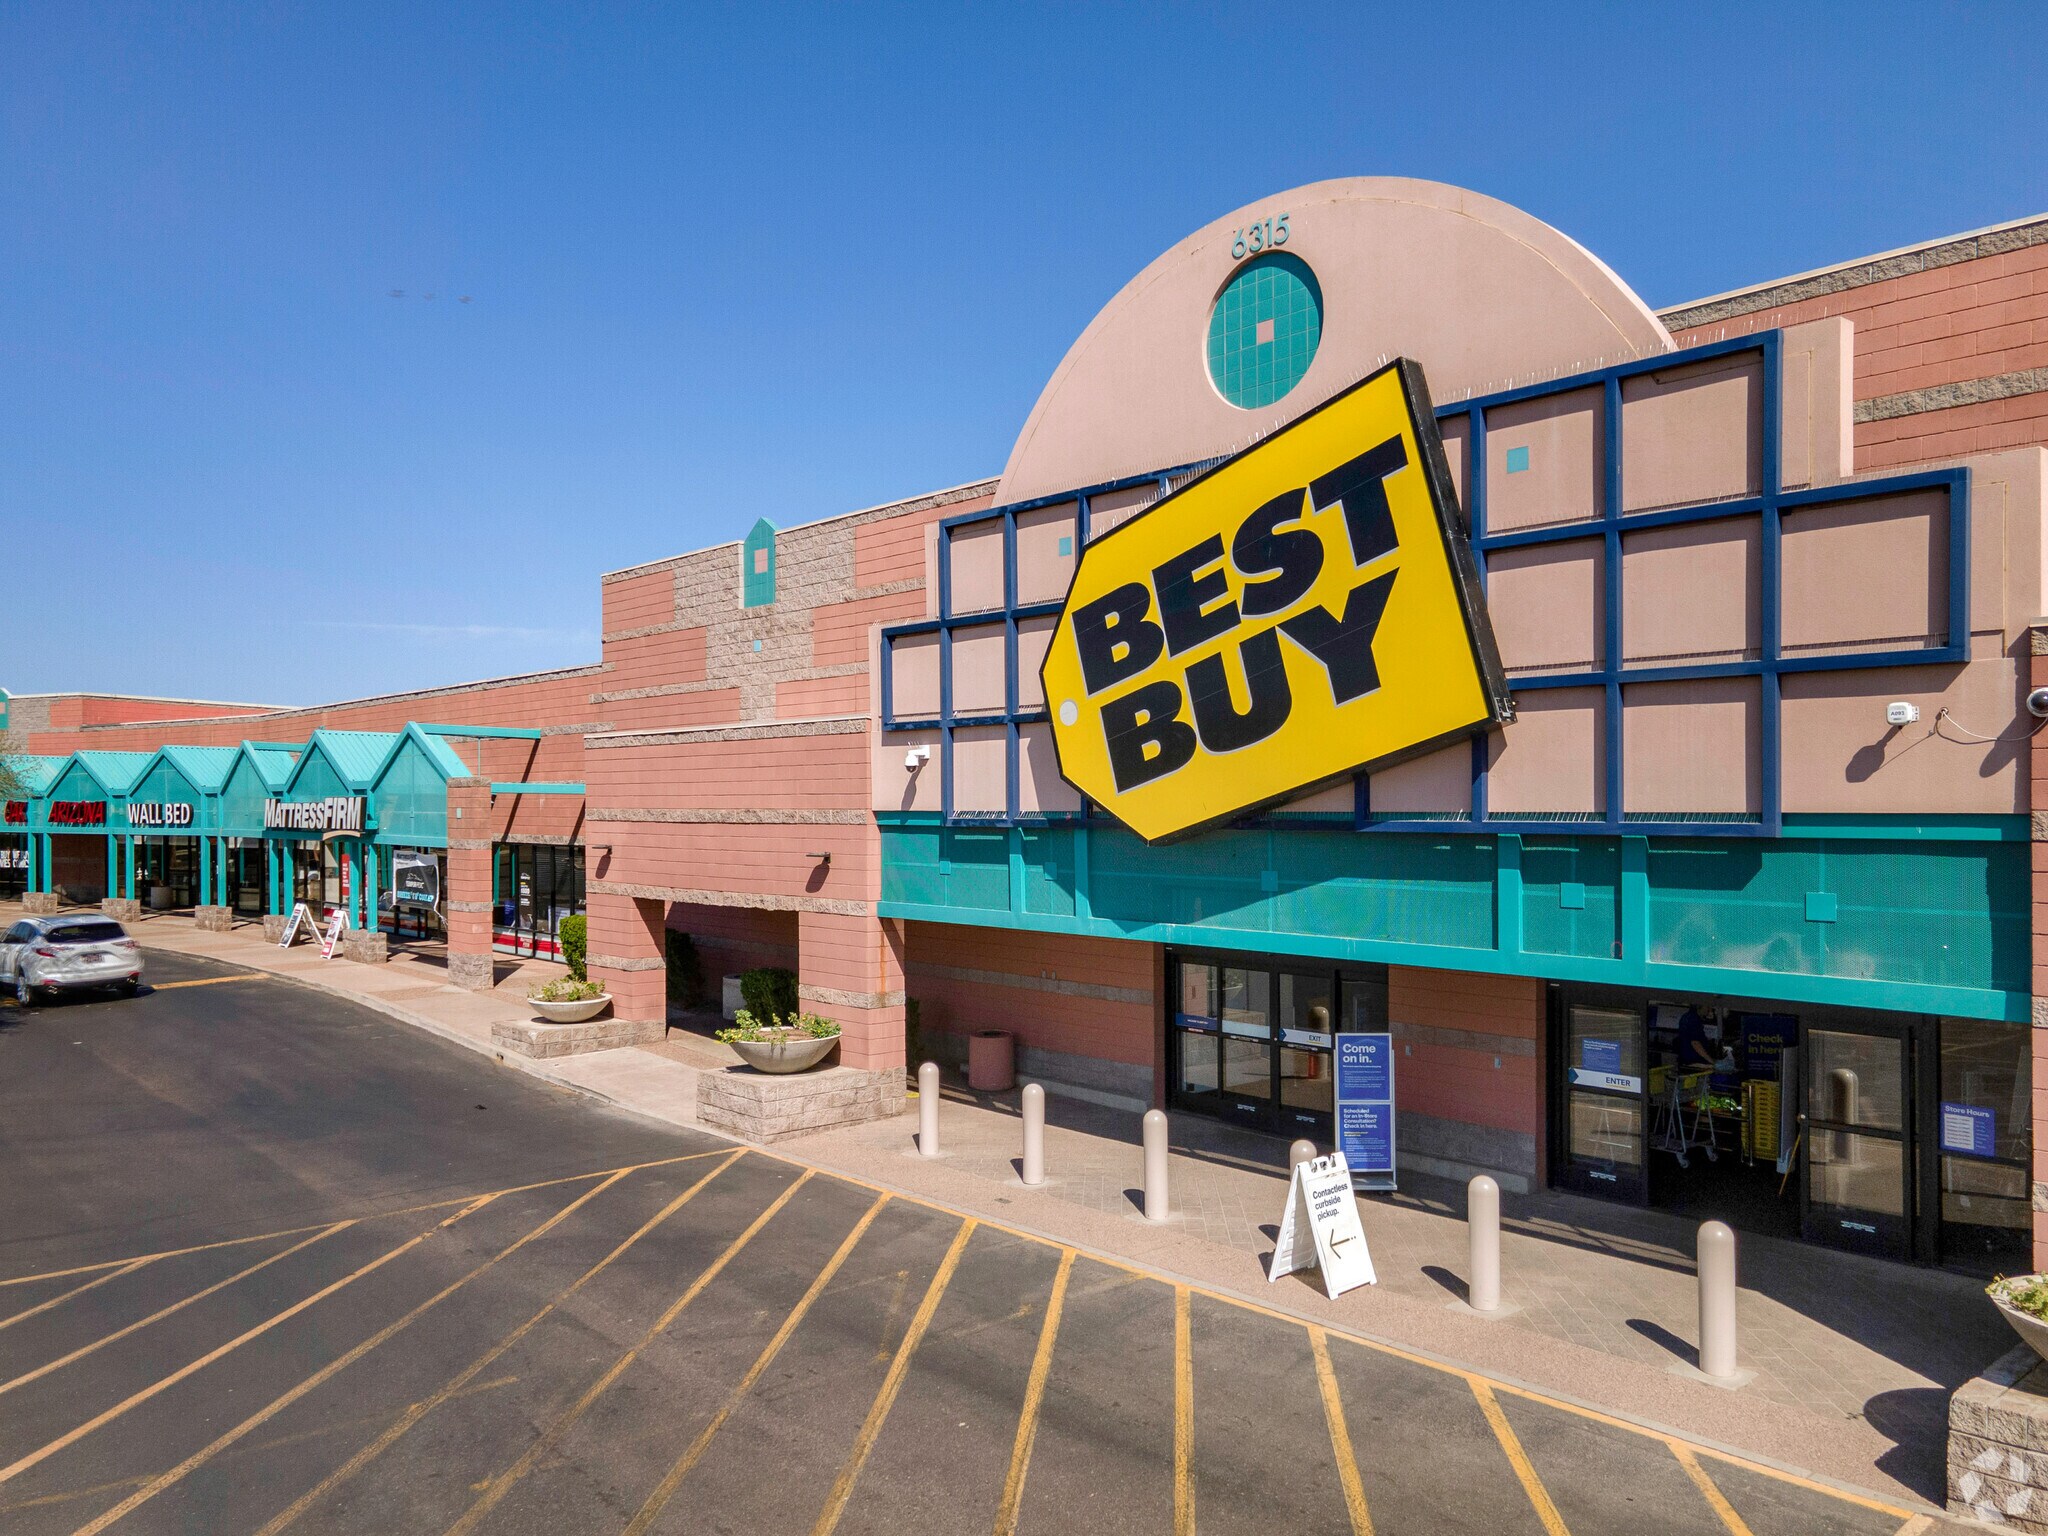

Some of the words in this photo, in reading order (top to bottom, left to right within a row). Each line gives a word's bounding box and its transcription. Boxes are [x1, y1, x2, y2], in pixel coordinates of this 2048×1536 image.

[1231, 212, 1290, 260] 6315
[1072, 434, 1409, 696] BEST
[1100, 567, 1400, 794] BUY
[48, 801, 106, 824] ARIZONA
[127, 803, 163, 824] WALL
[165, 803, 191, 824] BED
[1748, 1033, 1783, 1043] Check
[1342, 1043, 1376, 1053] Come
[1748, 1045, 1758, 1054] in
[1342, 1055, 1357, 1063] on
[1359, 1053, 1372, 1063] in.
[1605, 1076, 1631, 1086] ENTER
[1945, 1105, 1965, 1114] Store
[1966, 1109, 1990, 1118] Hours
[1312, 1184, 1348, 1199] Contactless
[1315, 1196, 1341, 1210] curbside
[1318, 1208, 1340, 1222] pickup.
